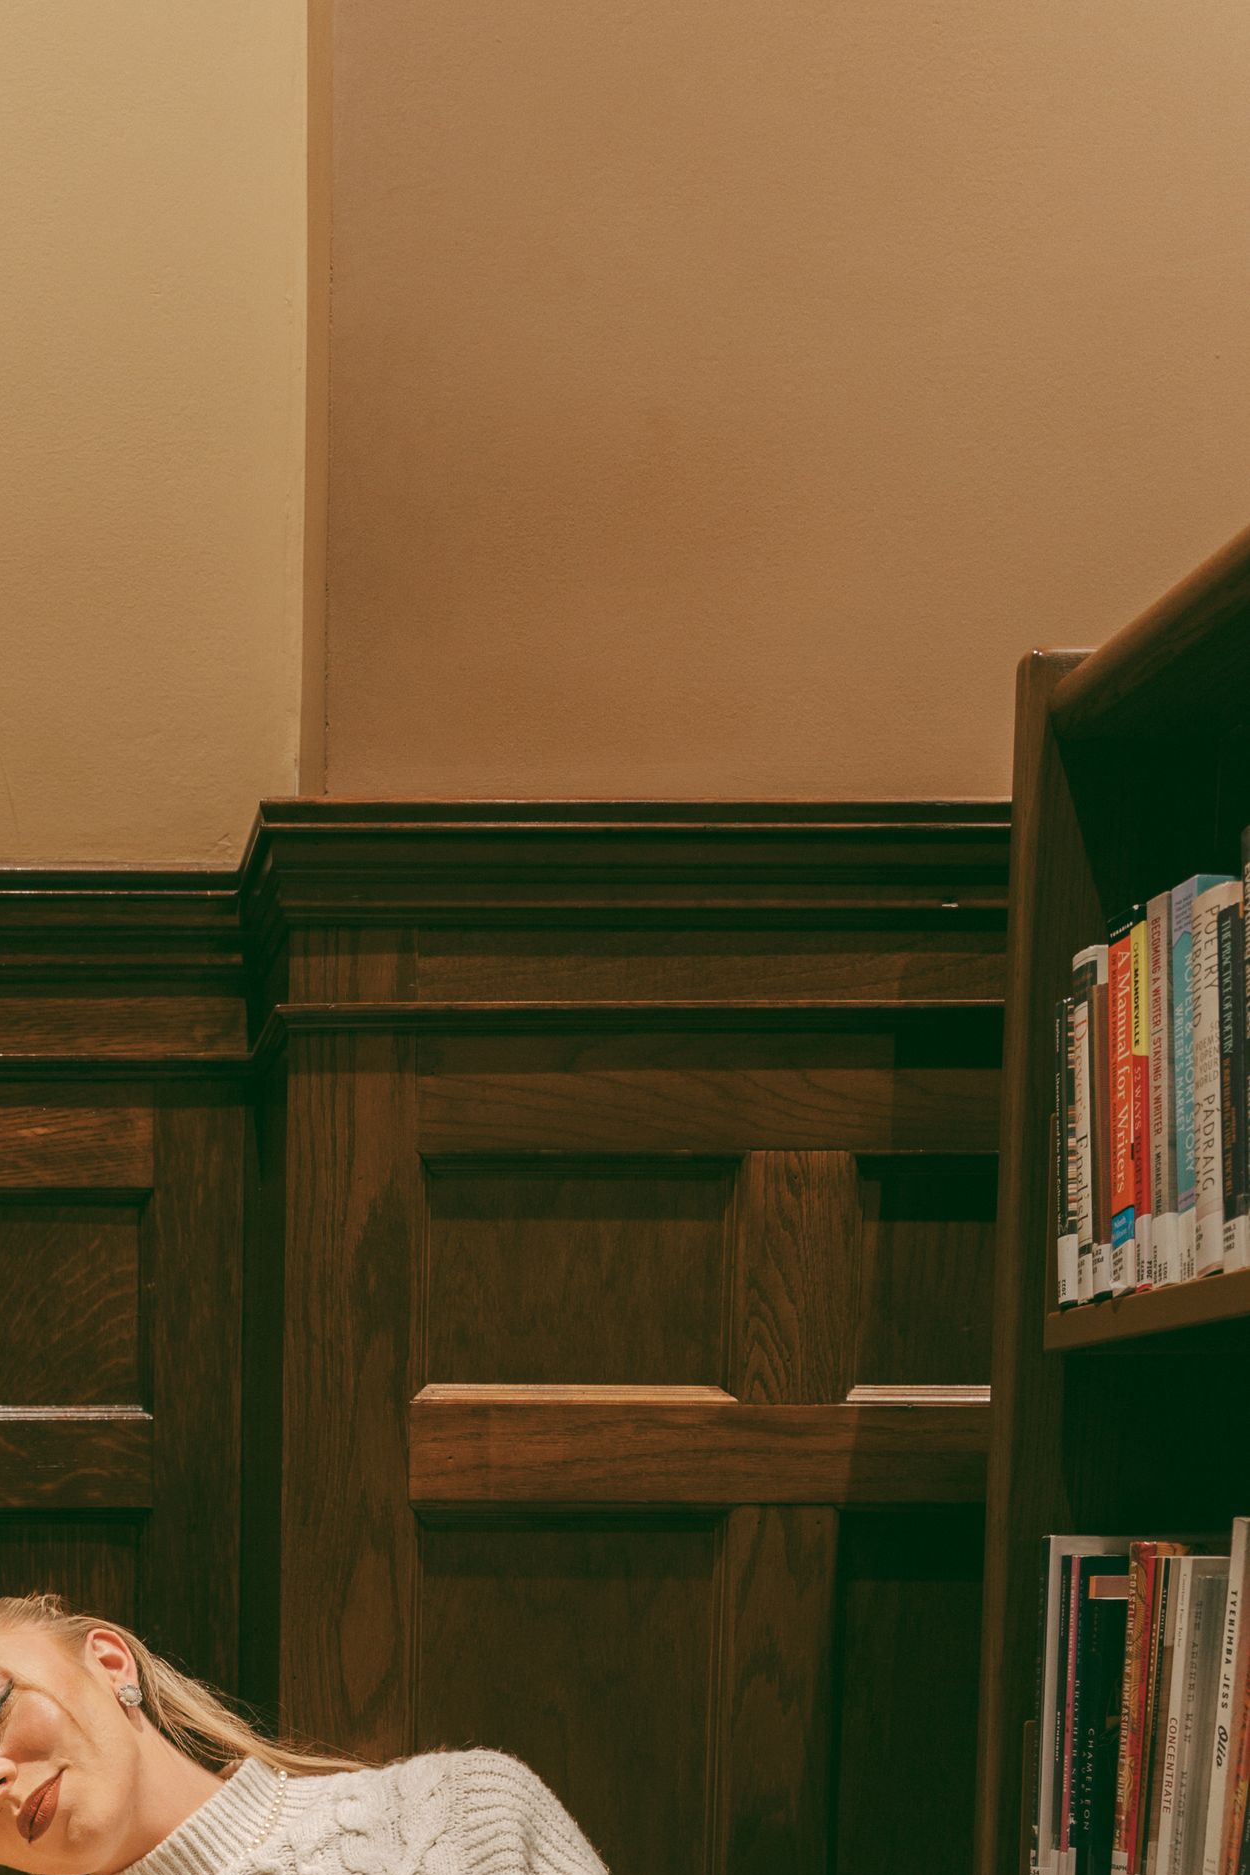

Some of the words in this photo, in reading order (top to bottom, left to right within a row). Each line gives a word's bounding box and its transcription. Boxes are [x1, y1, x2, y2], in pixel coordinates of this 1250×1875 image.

[1151, 916, 1162, 974] BECOMING
[1204, 904, 1221, 991] POETRY
[1222, 918, 1232, 941] THE
[1118, 950, 1130, 966] A
[1152, 977, 1161, 985] A
[1192, 914, 1203, 1028] UNBOUND
[1222, 942, 1232, 992] PRACTICE
[1152, 986, 1161, 1028] WRITER
[1184, 952, 1194, 1016] NOVEL
[1117, 969, 1131, 1063] Manual
[1174, 1002, 1184, 1067] WRITER'S
[1184, 1022, 1193, 1037] &
[1223, 1011, 1234, 1053] POETRY
[1133, 1065, 1142, 1083] 52
[1153, 1036, 1162, 1081] STAYING
[1184, 1043, 1194, 1103] SHORT
[1117, 1064, 1131, 1100] for
[1153, 1084, 1161, 1092] A
[1176, 1076, 1186, 1131] MARKET
[1133, 1085, 1143, 1130] WAYS
[1153, 1094, 1163, 1136] WRITER
[1116, 1103, 1129, 1194] Writers
[1185, 1112, 1195, 1172] STORY
[1202, 1093, 1221, 1191] PÁDRAIG
[1076, 1134, 1089, 1232] English
[1131, 1559, 1139, 1567] A
[1126, 1572, 1138, 1638] COASTLINE
[1194, 1599, 1204, 1630] THE
[1224, 1589, 1239, 1665] TYEHIMBA
[1124, 1657, 1132, 1674] AN
[1125, 1640, 1133, 1652] IS
[1187, 1640, 1200, 1702] ABSURD
[1221, 1673, 1231, 1710] JESS
[1119, 1677, 1132, 1763] IMMEASURABLE
[1183, 1712, 1194, 1743] MAN
[1162, 1716, 1179, 1814] CONCENTRATE
[1215, 1724, 1229, 1768] Olio
[1083, 1727, 1095, 1832] CHAMELEON
[1116, 1771, 1126, 1804] THING
[1178, 1770, 1189, 1817] MAJOR
